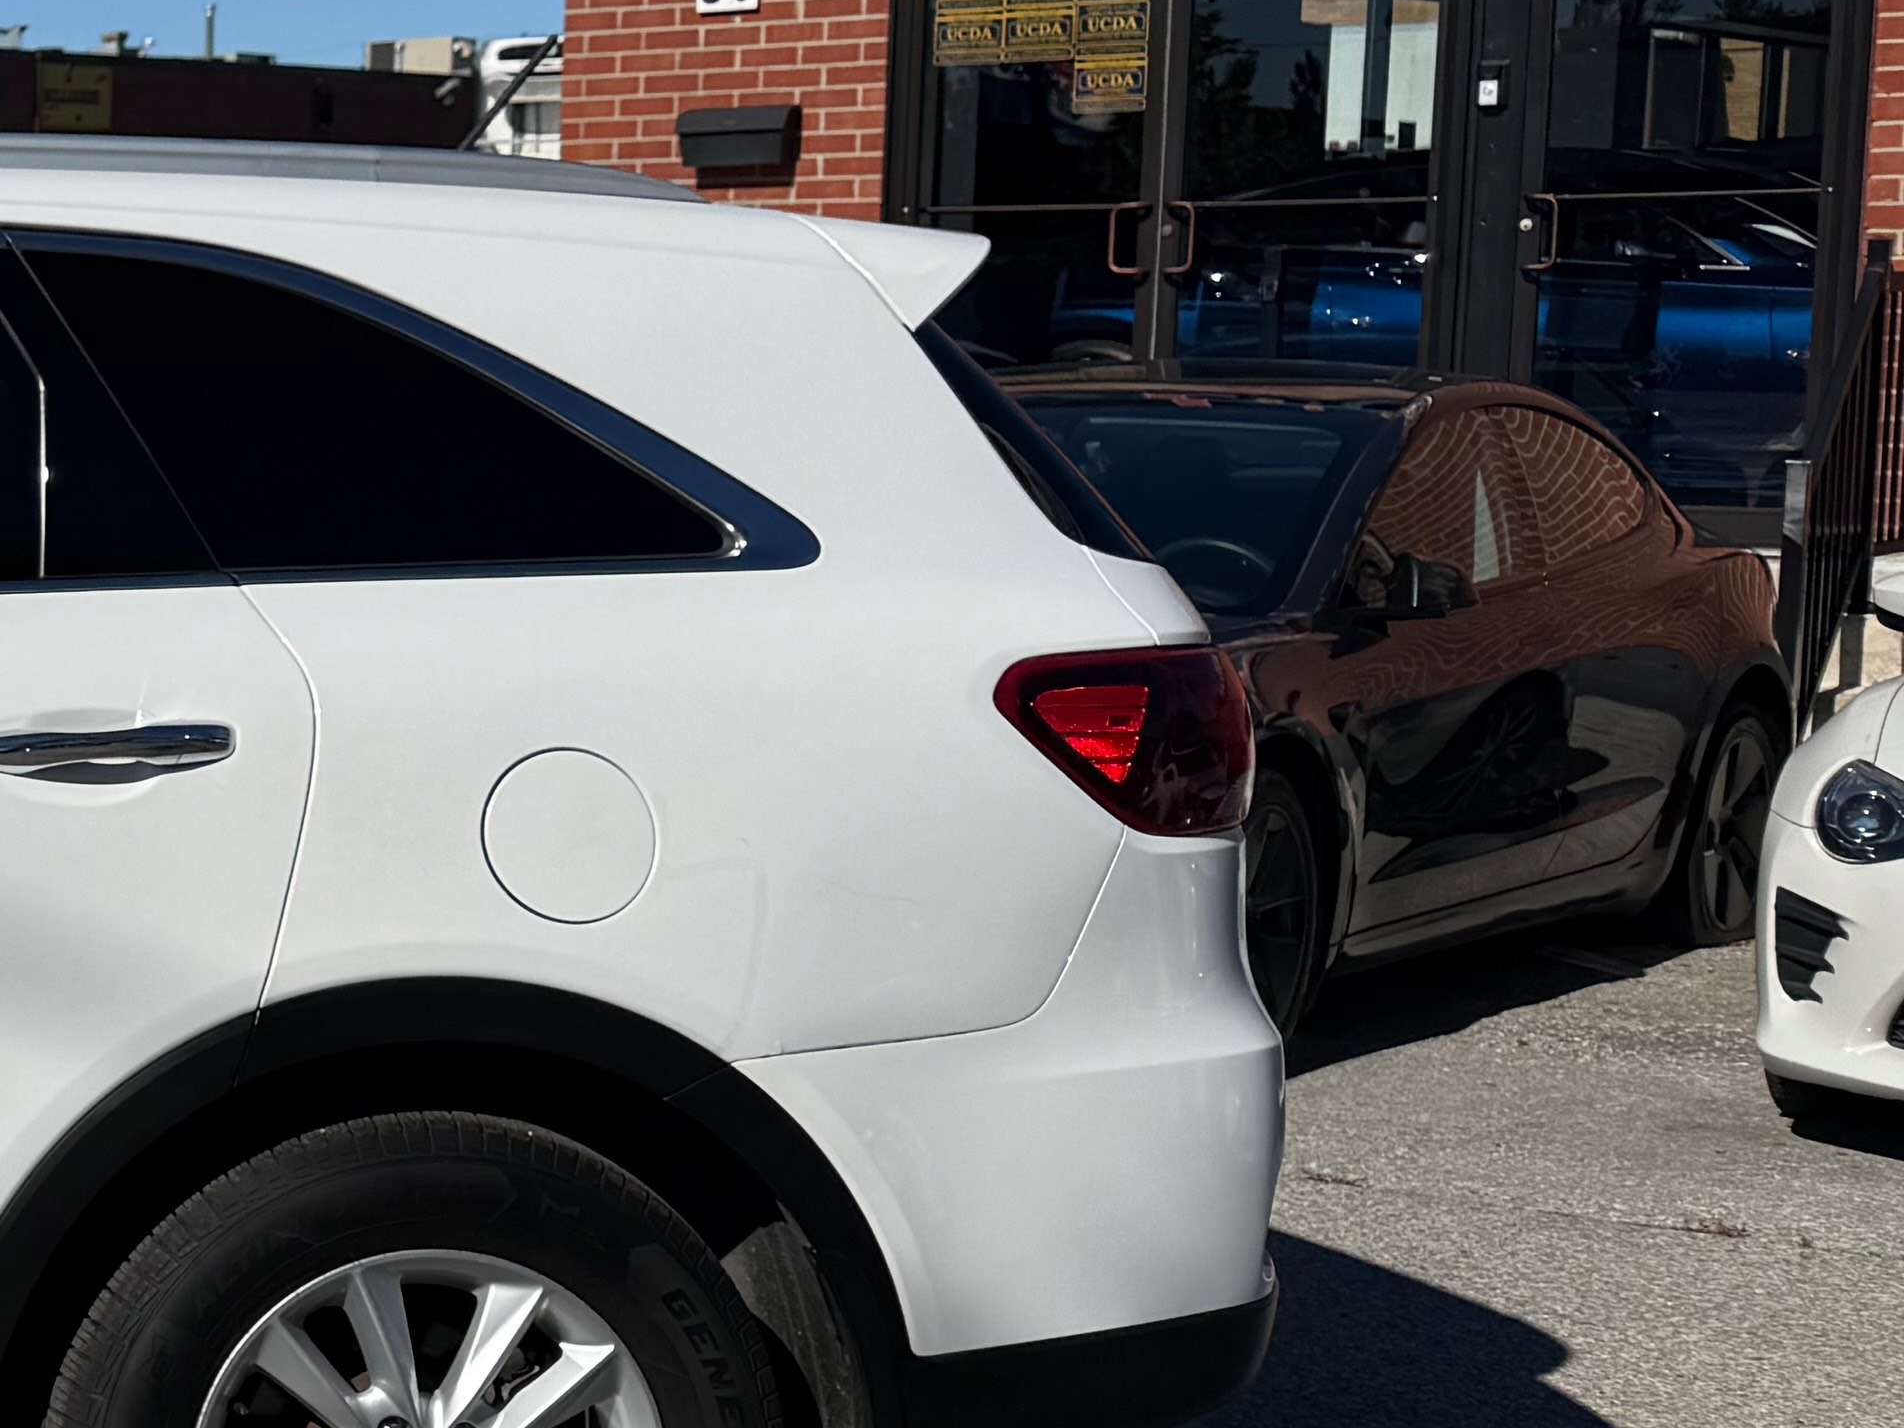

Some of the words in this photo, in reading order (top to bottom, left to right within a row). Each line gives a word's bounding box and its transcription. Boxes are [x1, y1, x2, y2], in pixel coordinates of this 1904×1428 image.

[1015, 22, 1064, 37] UCDA
[1086, 16, 1138, 32] UCDA
[946, 26, 993, 42] UCDA
[1086, 73, 1136, 88] UCDA
